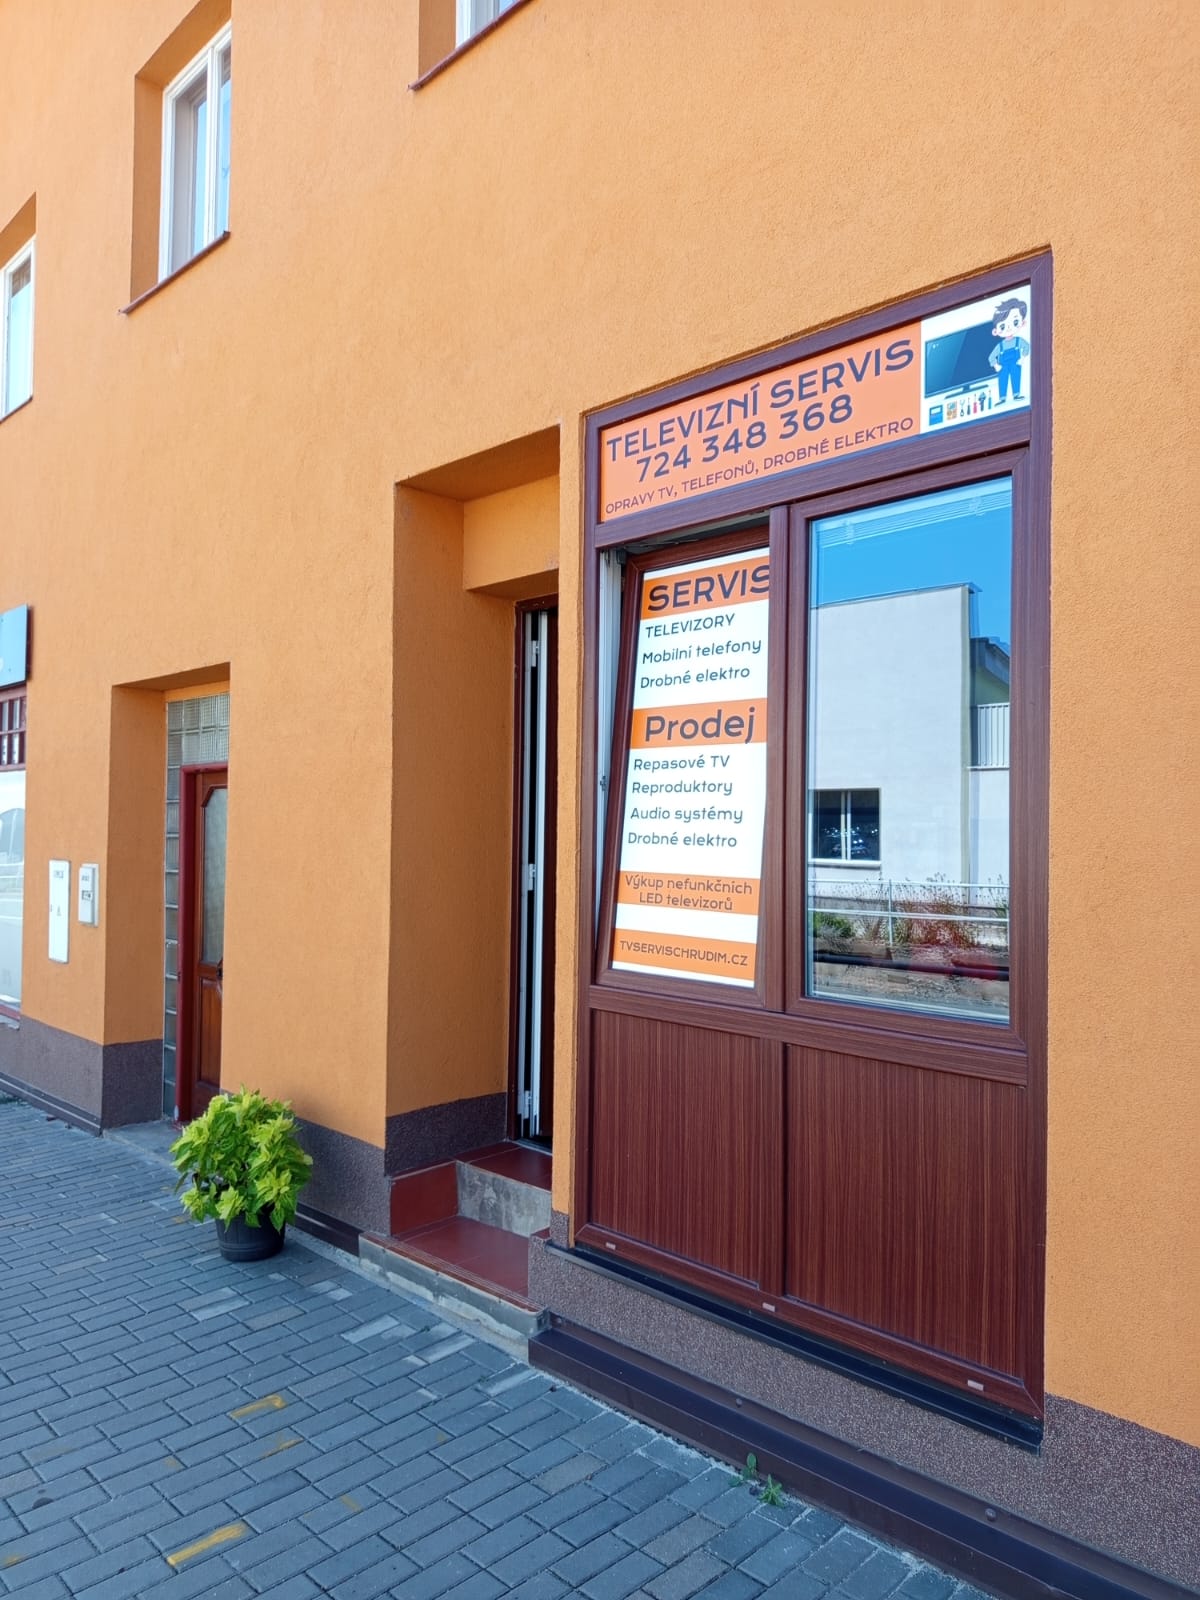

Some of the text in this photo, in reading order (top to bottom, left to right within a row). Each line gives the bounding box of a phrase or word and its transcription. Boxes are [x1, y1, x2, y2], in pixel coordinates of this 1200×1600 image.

[606, 339, 914, 463] TELEVIZNÍ SERVIS
[636, 394, 853, 483] 724 348 368
[605, 417, 914, 514] OPRAVY TV, TELEFONŮ, DROBNÉ ELEKTRO
[647, 565, 770, 611] SERVIS
[645, 613, 735, 639] TELEVIZORY
[642, 640, 762, 665] Mobilní telefony
[640, 667, 750, 688] Drobné elektro
[645, 706, 755, 744] Prodej
[634, 755, 730, 773] Repasové TV
[632, 779, 733, 796] Reproduktory
[630, 806, 743, 824] Audio systémy
[628, 832, 737, 847] Drobné elektro
[625, 874, 664, 890] Výkup
[639, 892, 733, 910] LED televizorů
[620, 940, 748, 966] TVSERVISCHRUDIM.CZ
